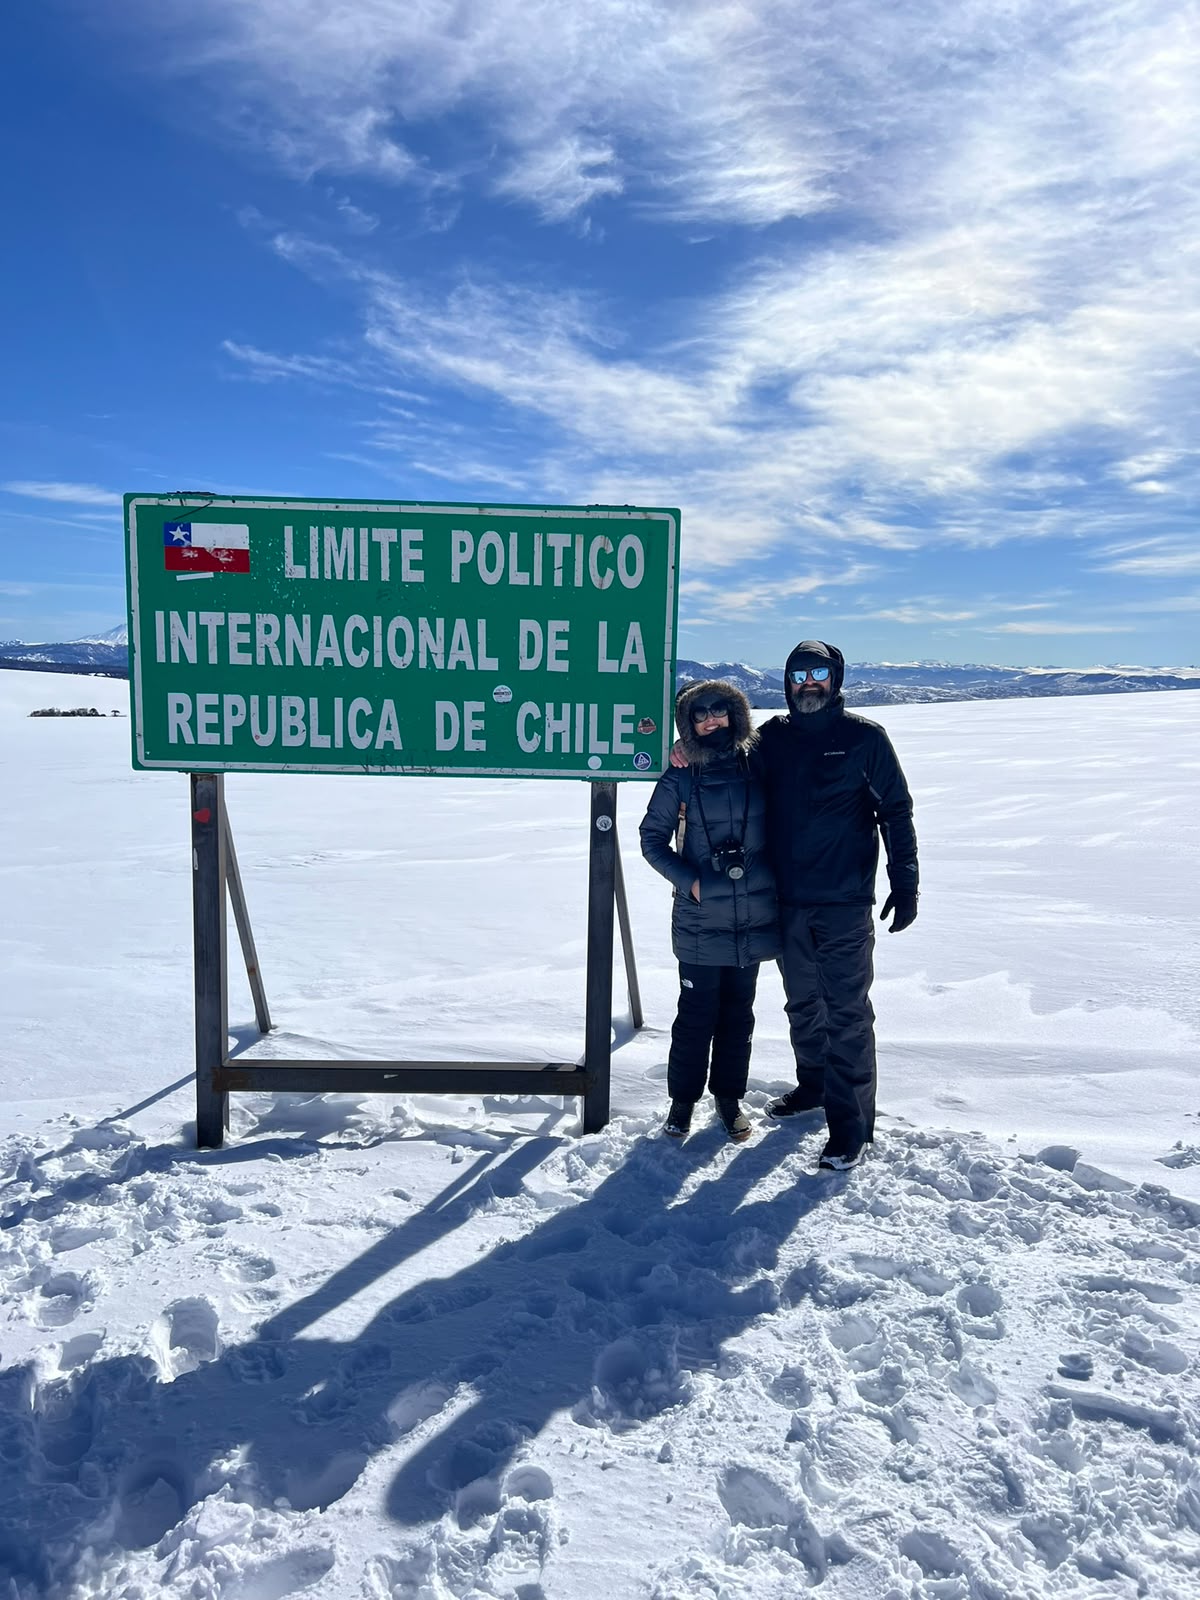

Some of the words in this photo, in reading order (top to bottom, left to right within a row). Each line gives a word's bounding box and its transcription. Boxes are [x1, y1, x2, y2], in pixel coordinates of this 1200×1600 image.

[285, 526, 424, 582] LIMITE
[452, 530, 644, 589] POLITICO
[156, 611, 498, 670] INTERNACIONAL
[519, 620, 569, 672] DE
[598, 622, 647, 672] LA
[168, 693, 402, 749] REPUBLICA
[436, 701, 485, 750] DE
[517, 702, 634, 754] CHILE
